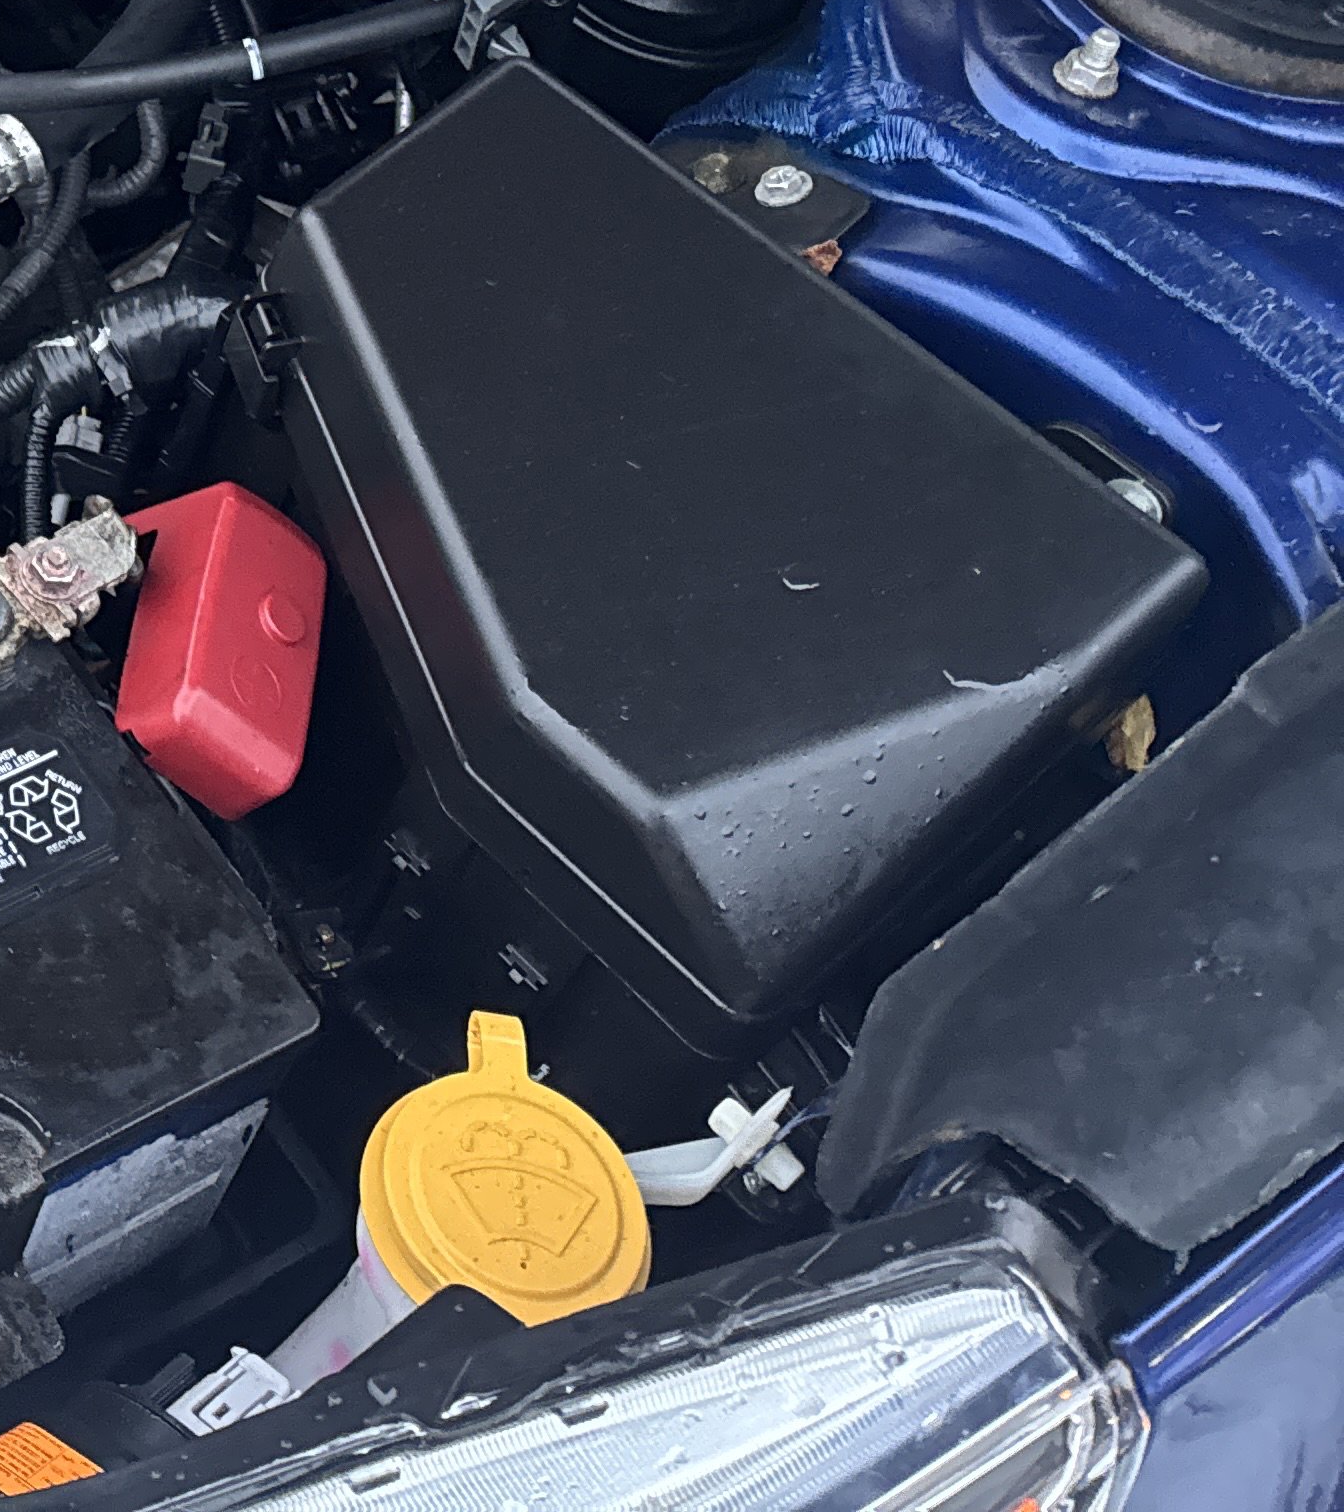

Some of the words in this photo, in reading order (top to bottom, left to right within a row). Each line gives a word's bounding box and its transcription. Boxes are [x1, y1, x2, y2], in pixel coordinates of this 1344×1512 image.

[12, 748, 40, 767] LEVEL
[45, 769, 83, 794] RETURN
[46, 831, 87, 855] RECYCLE
